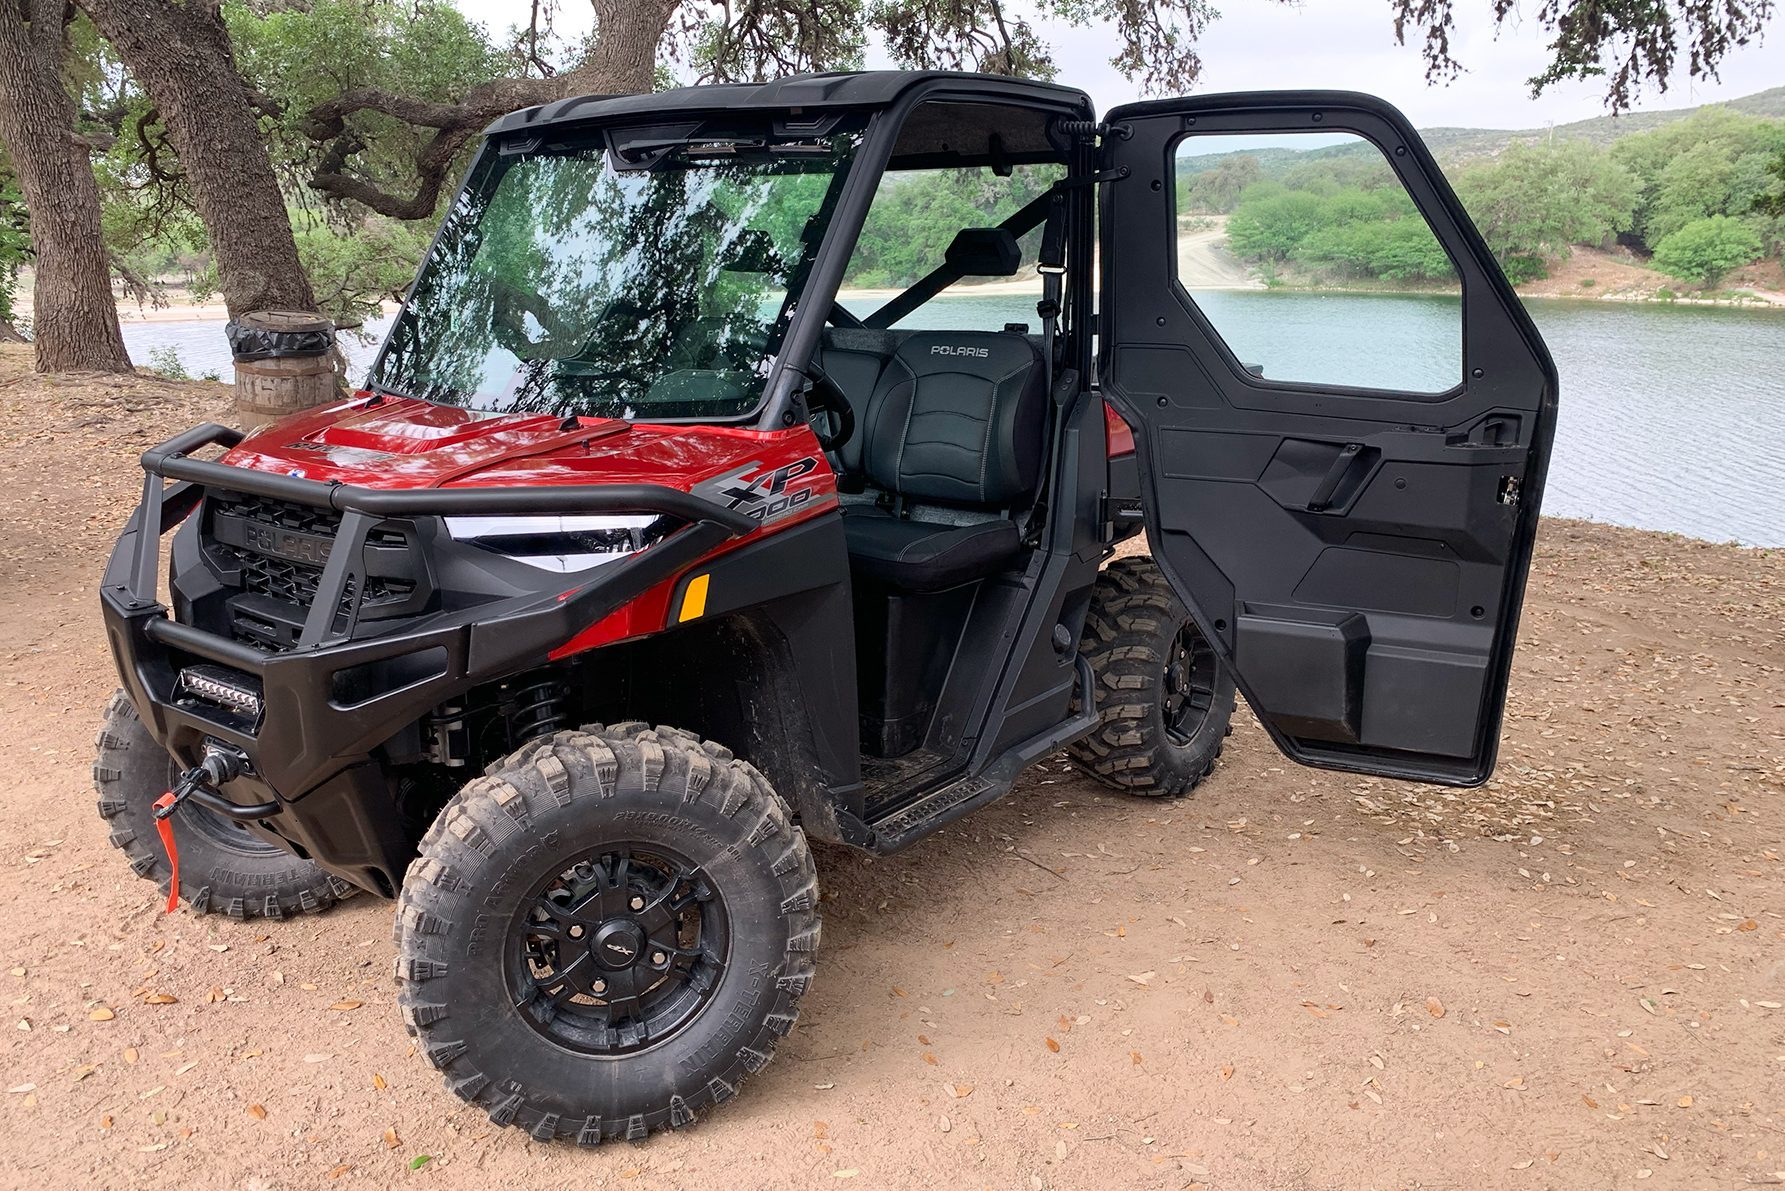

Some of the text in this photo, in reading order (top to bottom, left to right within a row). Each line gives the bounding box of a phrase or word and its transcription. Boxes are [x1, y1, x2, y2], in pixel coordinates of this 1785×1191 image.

[930, 345, 989, 358] POLARIS
[719, 456, 820, 510] XP
[678, 959, 769, 1077] X-TERRAIN
